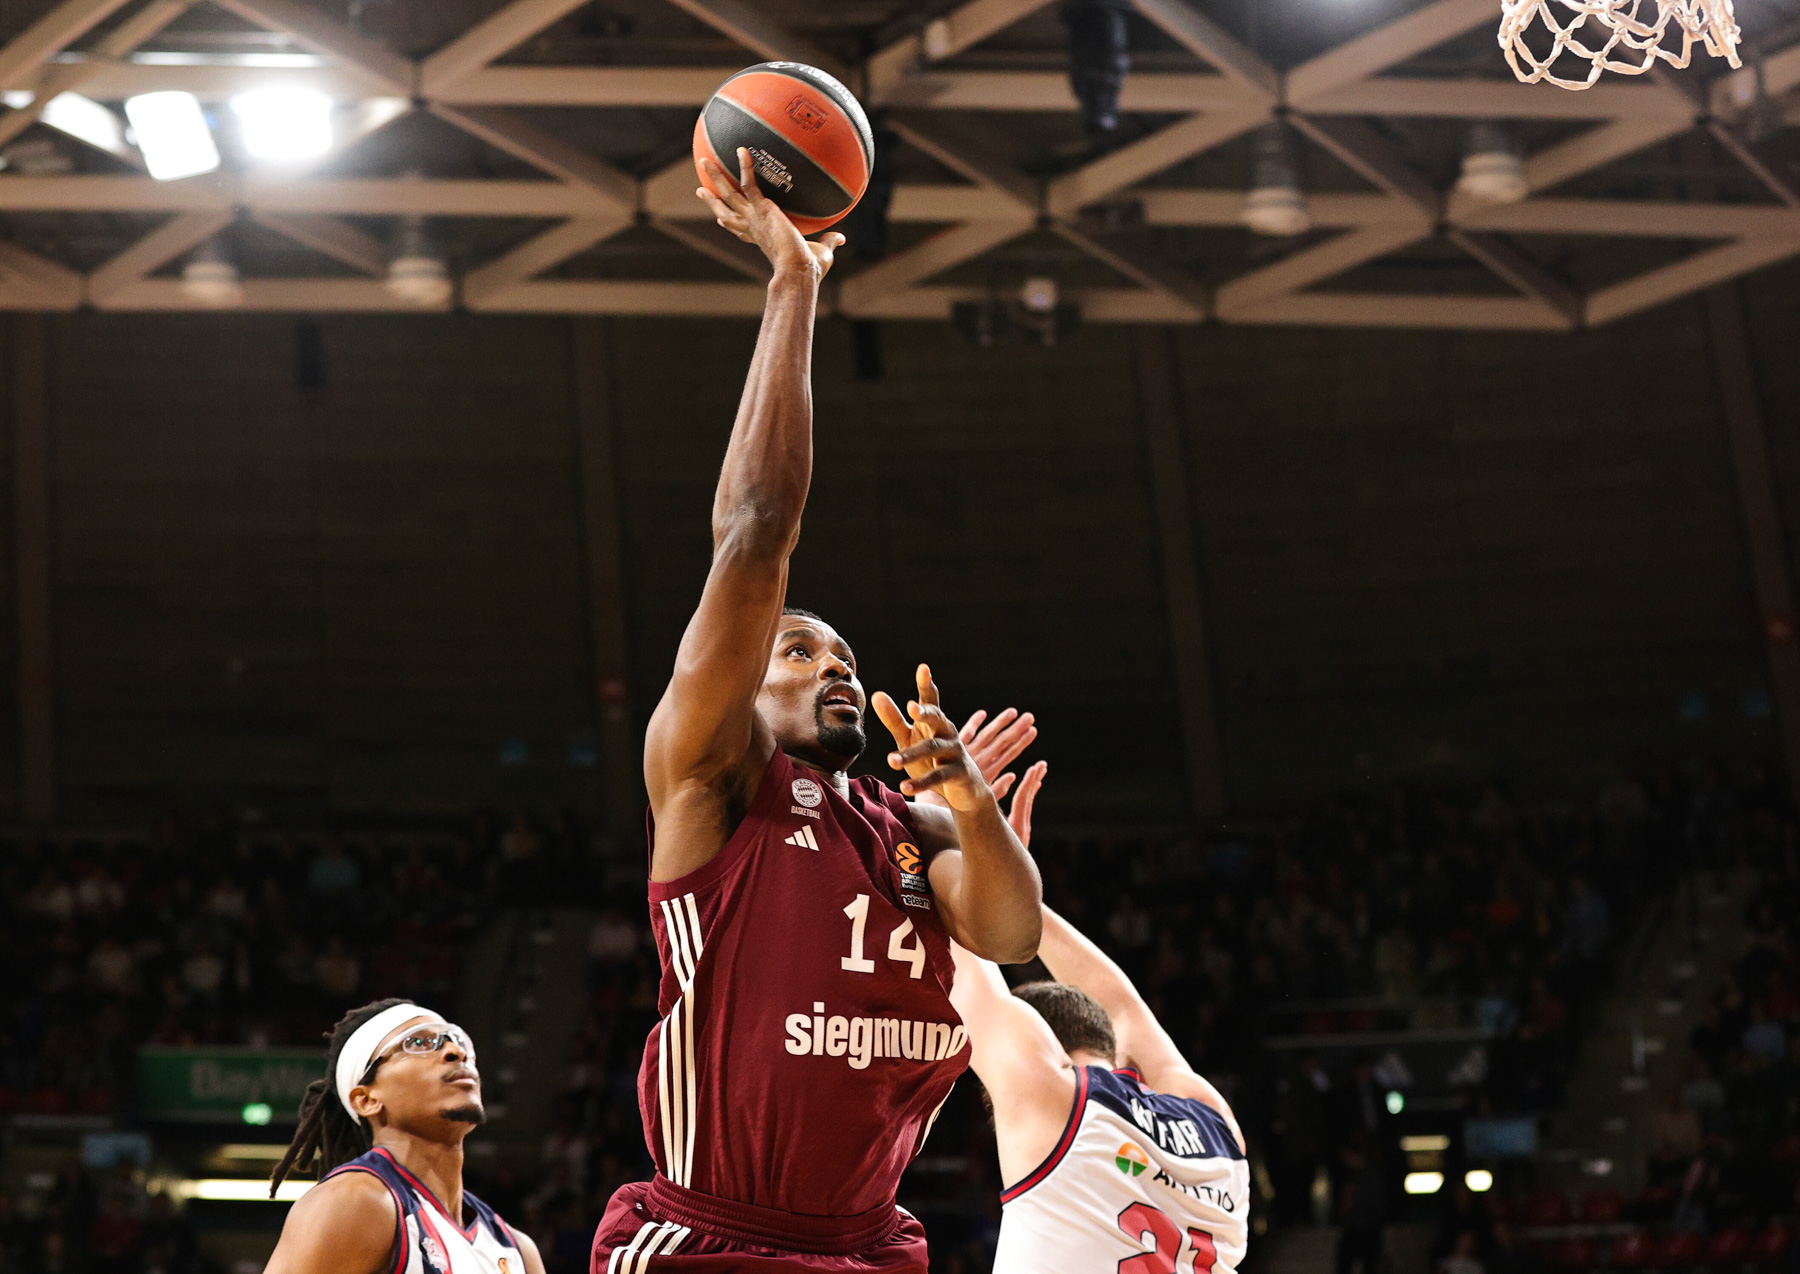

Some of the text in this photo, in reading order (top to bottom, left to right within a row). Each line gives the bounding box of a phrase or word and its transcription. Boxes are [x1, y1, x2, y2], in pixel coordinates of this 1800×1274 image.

[791, 805, 821, 820] BASKETBALL
[841, 893, 926, 980] 14
[1117, 1200, 1218, 1274] 21
